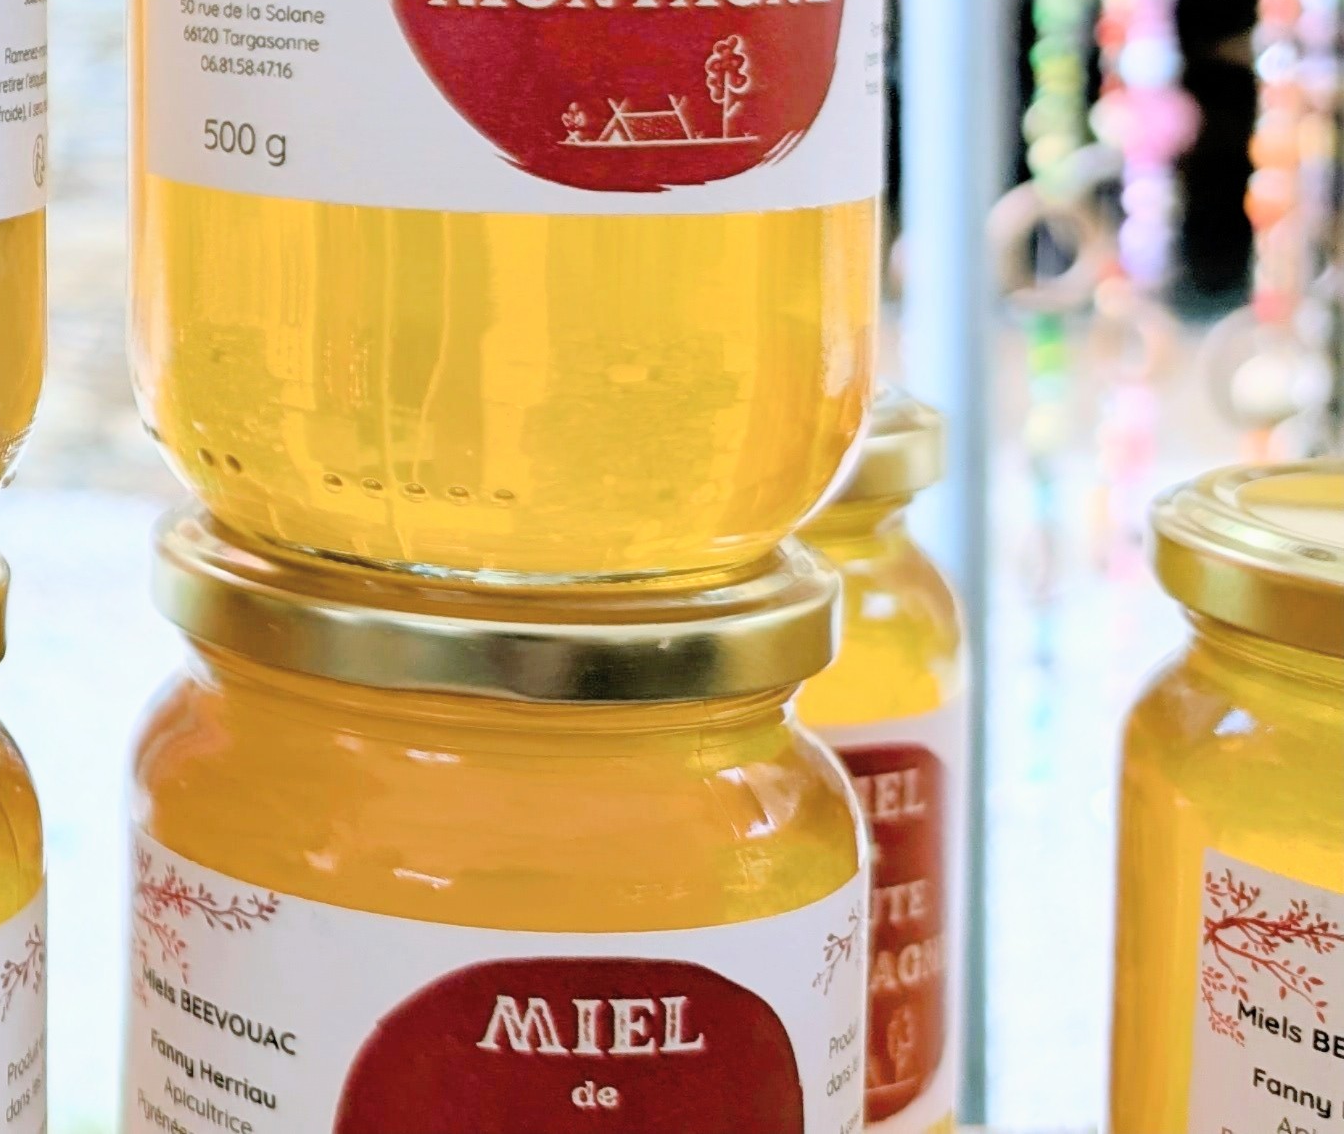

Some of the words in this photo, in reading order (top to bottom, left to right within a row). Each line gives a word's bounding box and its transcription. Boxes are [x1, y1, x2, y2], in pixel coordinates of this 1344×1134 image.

[198, 3, 219, 17] rue
[223, 2, 242, 19] de
[247, 4, 260, 20] la
[265, 4, 325, 24] Solane
[183, 26, 218, 44] 66120
[223, 28, 320, 52] Targasonne
[204, 119, 256, 155] 500
[265, 133, 286, 167] g
[142, 964, 176, 1005] Miels
[180, 988, 296, 1056] BEEVOUAC
[476, 995, 705, 1055] MIEL
[1238, 999, 1302, 1044] Miels
[150, 1028, 194, 1078] Fanny
[200, 1059, 277, 1109] Herriau
[570, 1080, 620, 1109] de
[1253, 1067, 1331, 1119] Fanny
